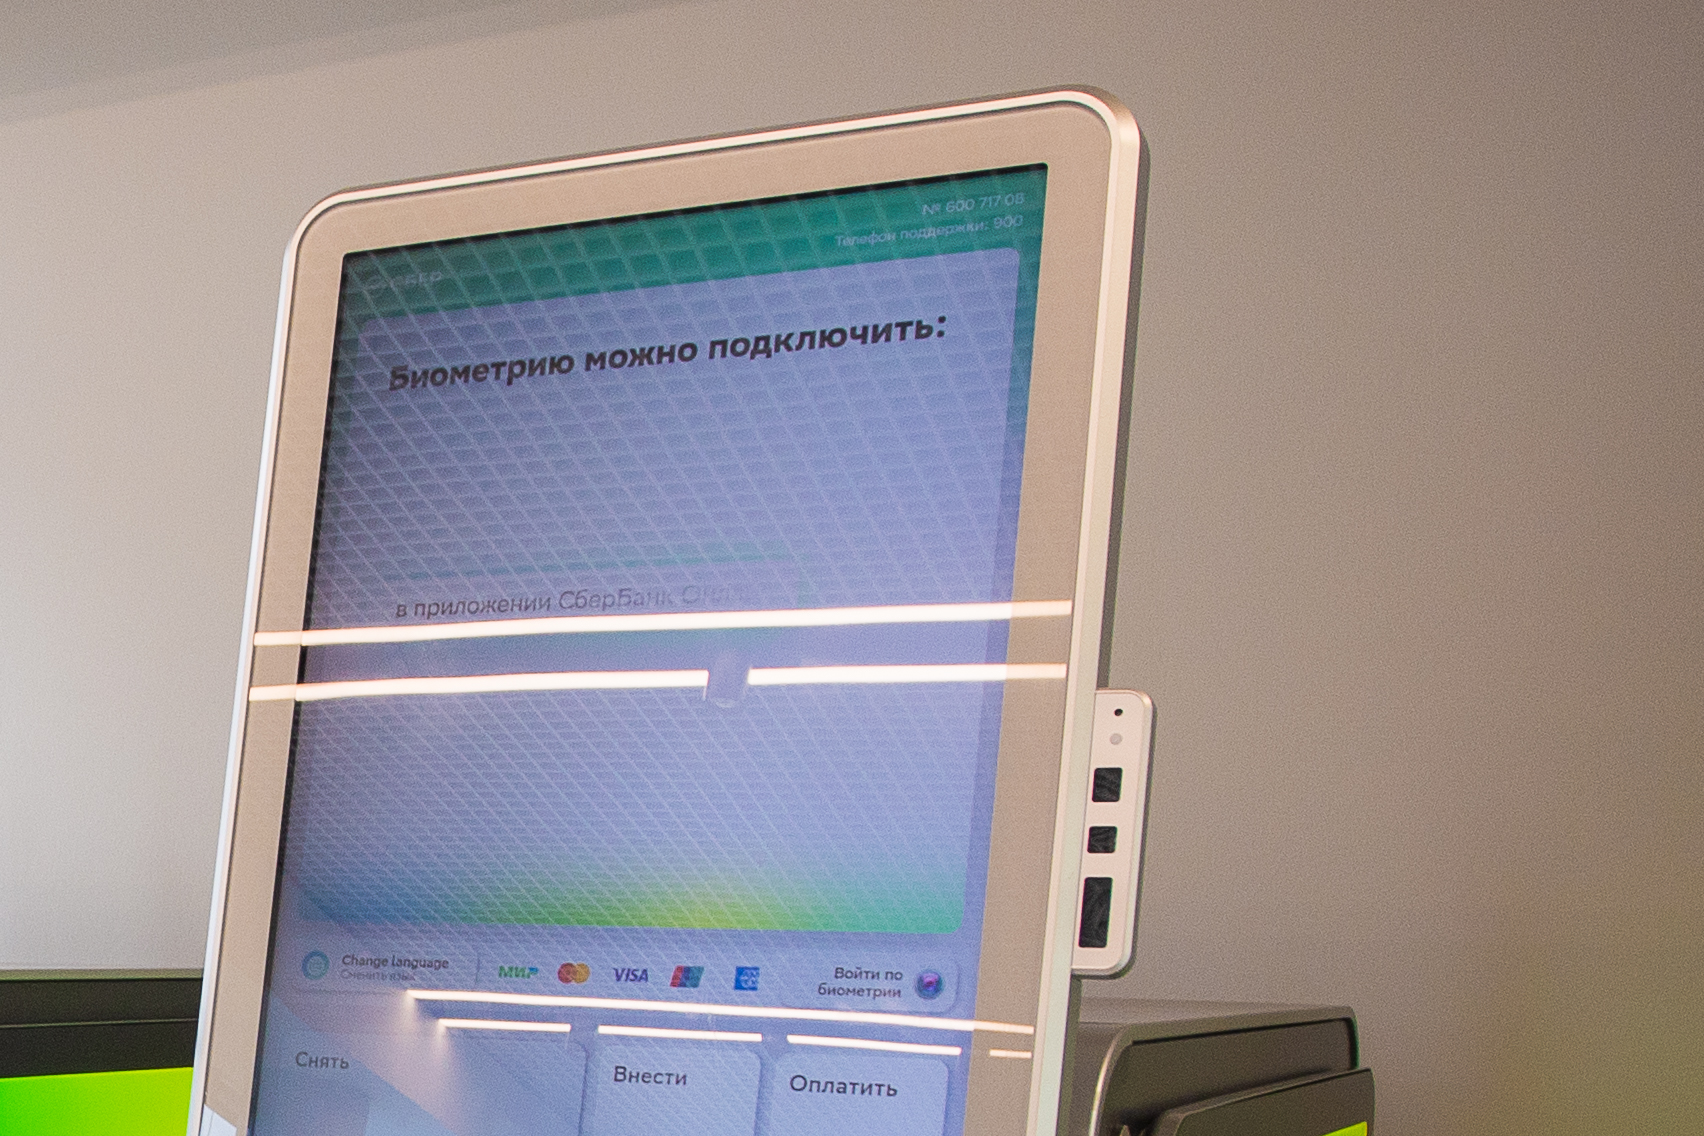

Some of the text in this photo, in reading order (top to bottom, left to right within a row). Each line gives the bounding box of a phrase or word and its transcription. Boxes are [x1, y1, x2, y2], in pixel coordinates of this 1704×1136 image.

[836, 214, 1024, 247] Телефон поддержки: 900
[388, 314, 947, 392] Биометрию можно подключить:
[396, 603, 407, 619] в
[414, 596, 552, 621] приложении
[558, 588, 675, 612] СберБанк
[341, 953, 450, 972] Change language
[612, 967, 649, 983] VISA
[834, 966, 903, 981] Войти по
[818, 982, 901, 1000] биометрии
[296, 1051, 350, 1070] Снять
[614, 1065, 687, 1086] Внести
[790, 1074, 898, 1097] Оплатить
